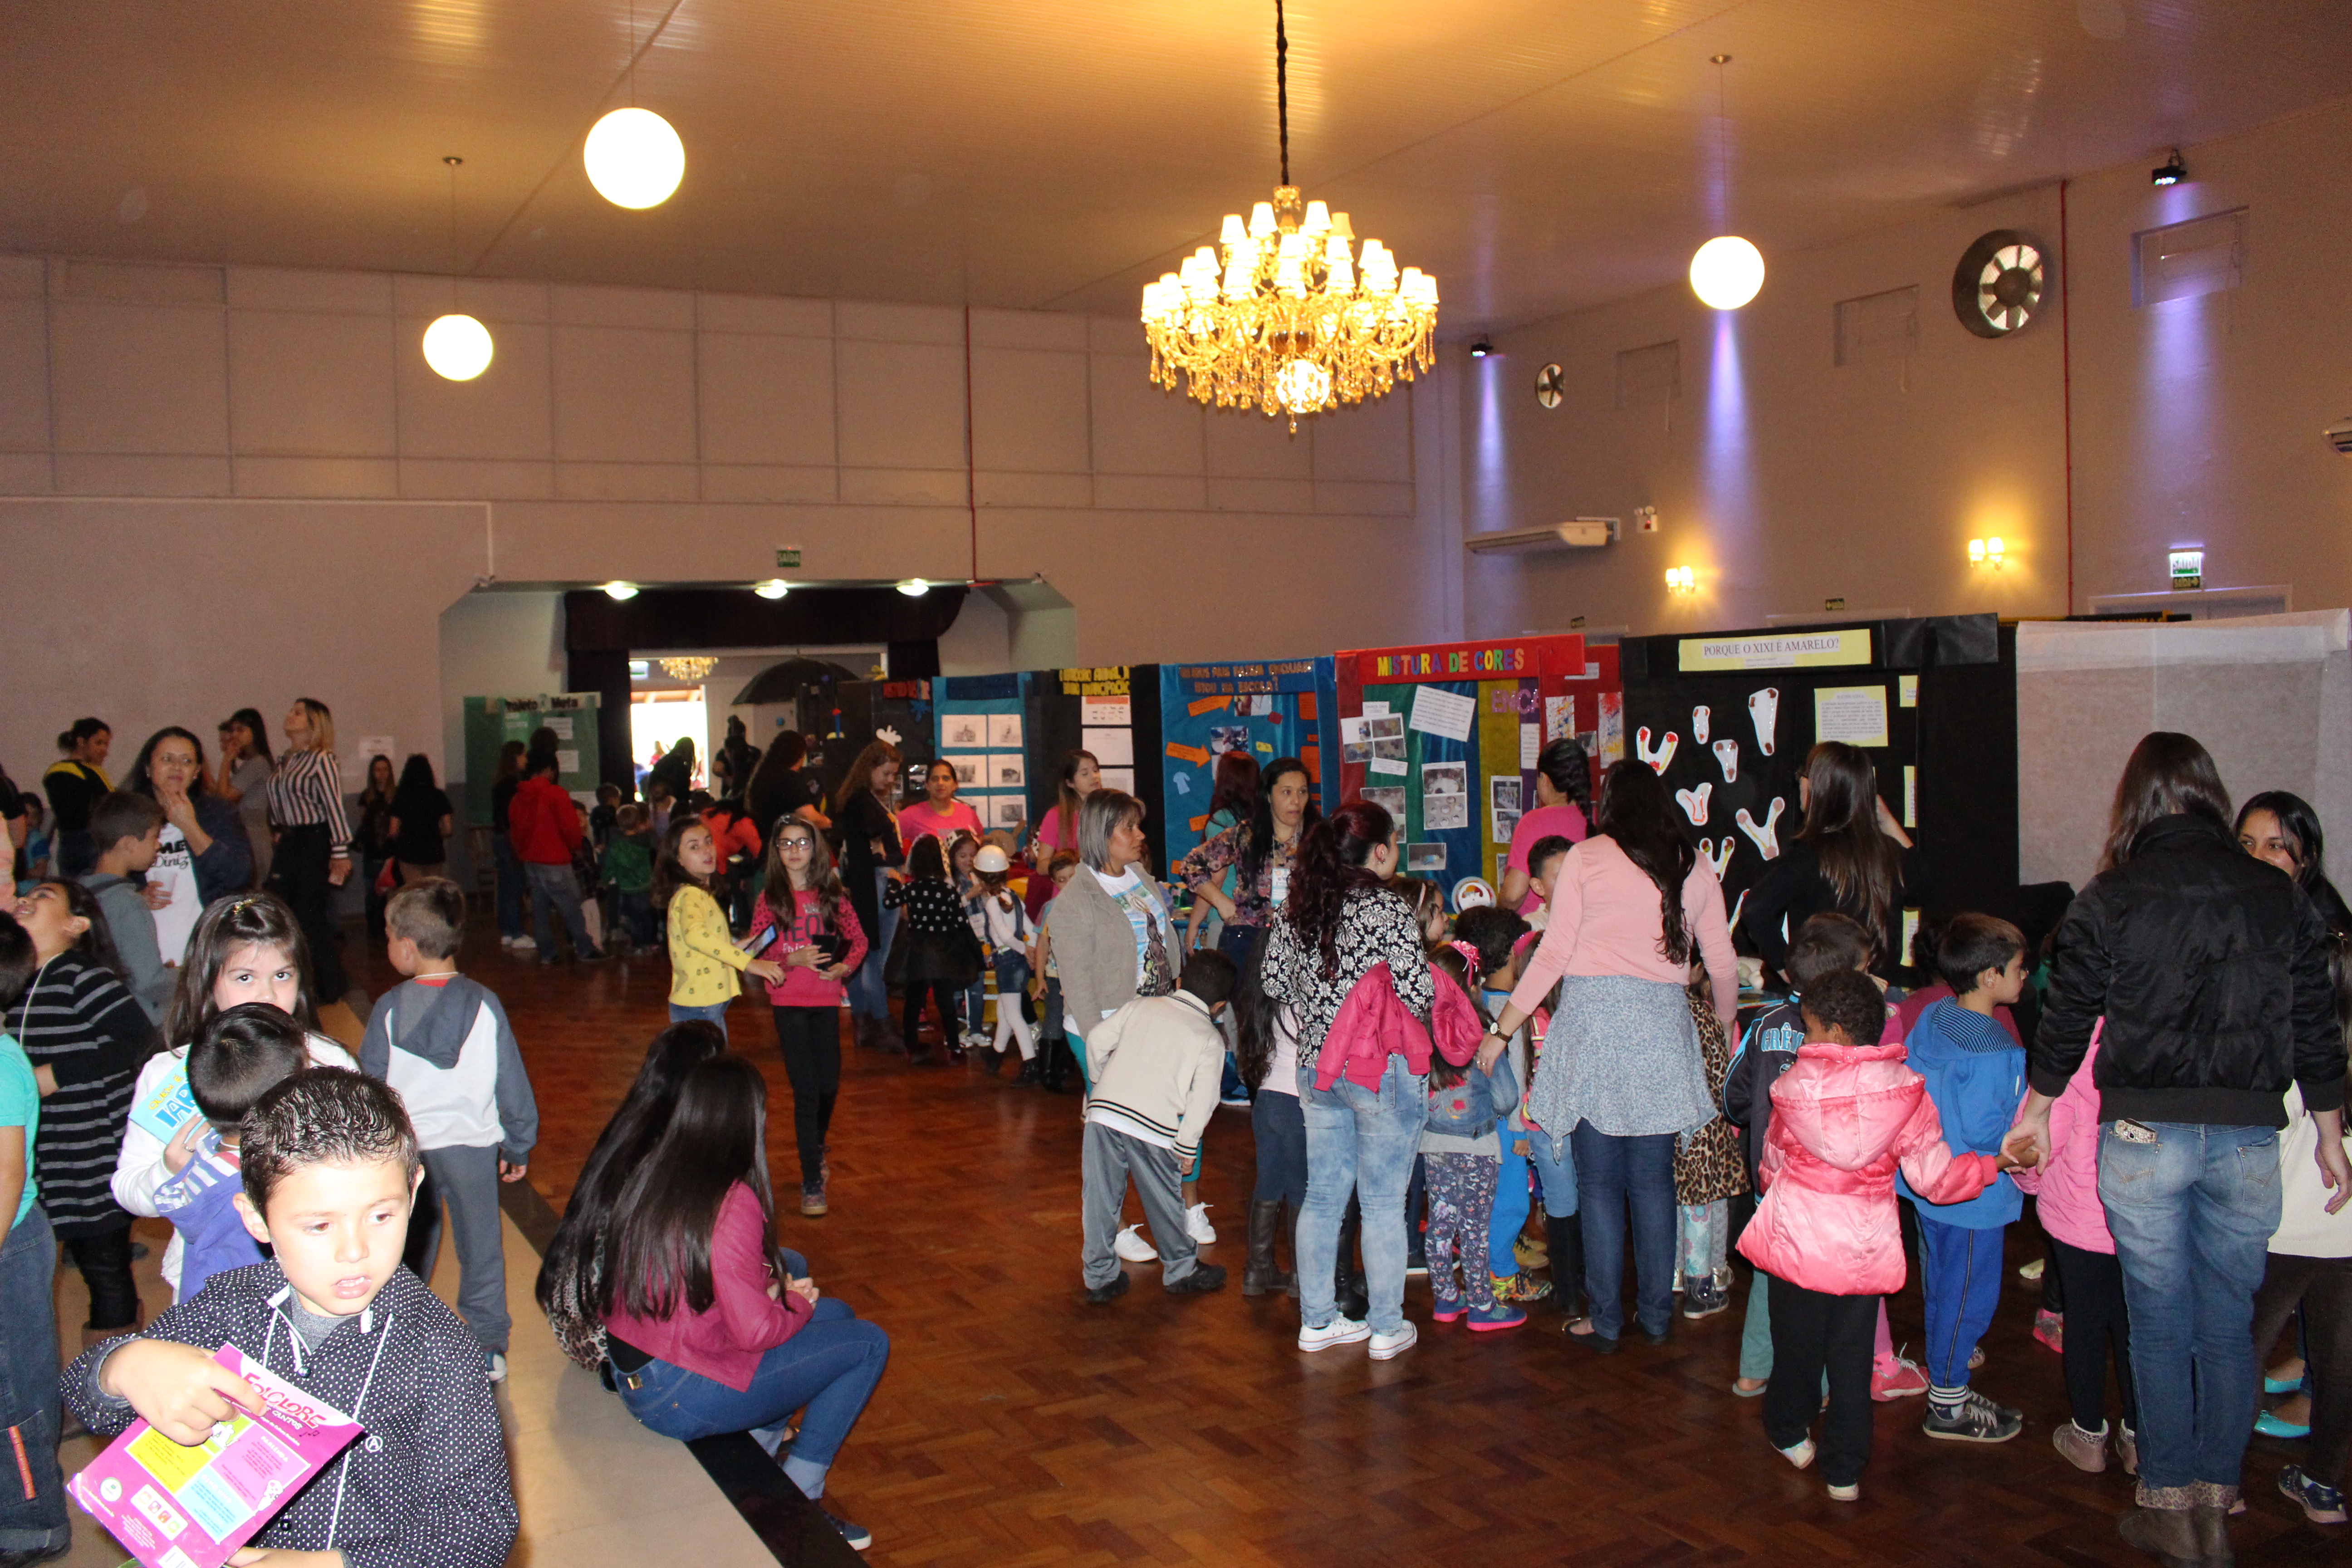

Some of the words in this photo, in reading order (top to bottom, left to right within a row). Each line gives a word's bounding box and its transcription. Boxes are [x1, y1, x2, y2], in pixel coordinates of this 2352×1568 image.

[1704, 643, 1740, 656] PORQUE
[1743, 644, 1751, 653] O
[1753, 642, 1774, 653] XIXI
[1776, 638, 1782, 652] É
[1784, 637, 1839, 652] AMARELO?
[1377, 653, 1443, 677] MISTURA
[1449, 651, 1469, 673] DE
[1474, 647, 1525, 671] CORES
[1491, 687, 1539, 715] ENCA
[1761, 1021, 1805, 1054] GRÊM
[148, 1083, 175, 1110] QUEM
[173, 1073, 184, 1083] É
[153, 1082, 196, 1130] IAR
[243, 1372, 327, 1430] FOLCLORE
[272, 1408, 303, 1430] CANTOS
[260, 1435, 289, 1463] PARLENDA
[217, 1489, 233, 1504] VIVO
